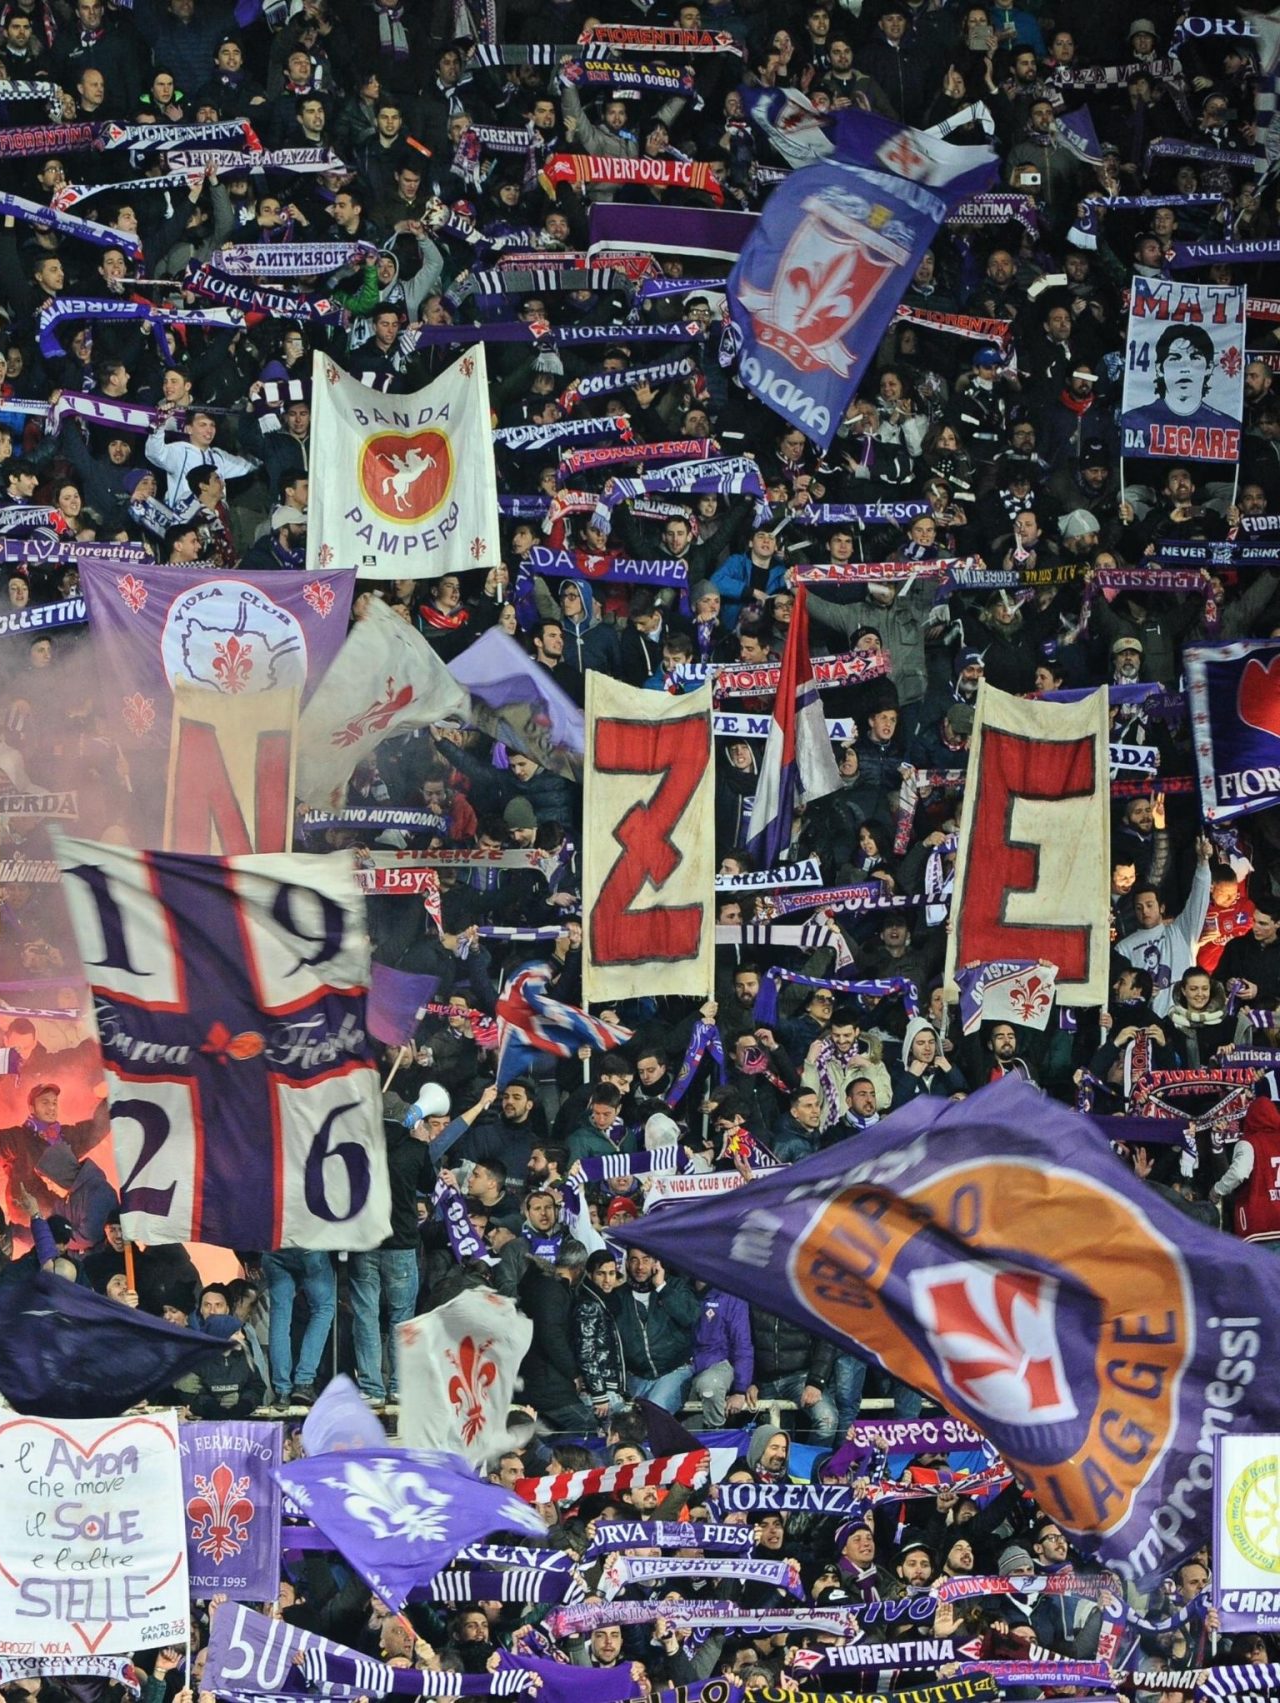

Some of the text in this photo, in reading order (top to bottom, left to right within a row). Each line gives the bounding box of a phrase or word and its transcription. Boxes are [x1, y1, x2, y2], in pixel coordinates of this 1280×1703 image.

[595, 28, 714, 46] FIORENTINA
[613, 71, 640, 85] SONO
[0, 126, 93, 151] FIORENTINA
[125, 120, 244, 144] FIORENTINA
[188, 148, 322, 167] FORZA RAGAZZI
[590, 158, 693, 186] LIVERPOOL FC
[192, 271, 313, 312] FIORENTINA
[559, 322, 682, 341] FIORENTINA
[1128, 339, 1152, 374] 14
[578, 357, 692, 397] COLLETTIVO
[353, 402, 451, 429] BANDA
[1124, 422, 1241, 462] DA LEGARE
[58, 541, 146, 561] Fiorentina
[1161, 546, 1280, 559] NEVER DRINK
[174, 587, 292, 626] VIOLA CLUB
[730, 858, 819, 888] MERDA
[669, 1176, 721, 1192] VIOLA CLUB
[194, 1433, 273, 1461] FERMENTO
[853, 1421, 938, 1450] GRUPPO
[27, 1476, 125, 1498] che move
[25, 1502, 144, 1545] il SOLE
[31, 1554, 45, 1569] e
[188, 1576, 248, 1588] SINCE 1995
[140, 1624, 170, 1637] CANTO
[140, 1628, 187, 1645] PARADISO
[40, 1641, 72, 1654] VIOLA
[825, 1641, 955, 1667] FIORENTINA
[1007, 1673, 1033, 1681] CONTRO
[1035, 1672, 1055, 1681] TUTTO
[1062, 1672, 1081, 1681] TUTTI
